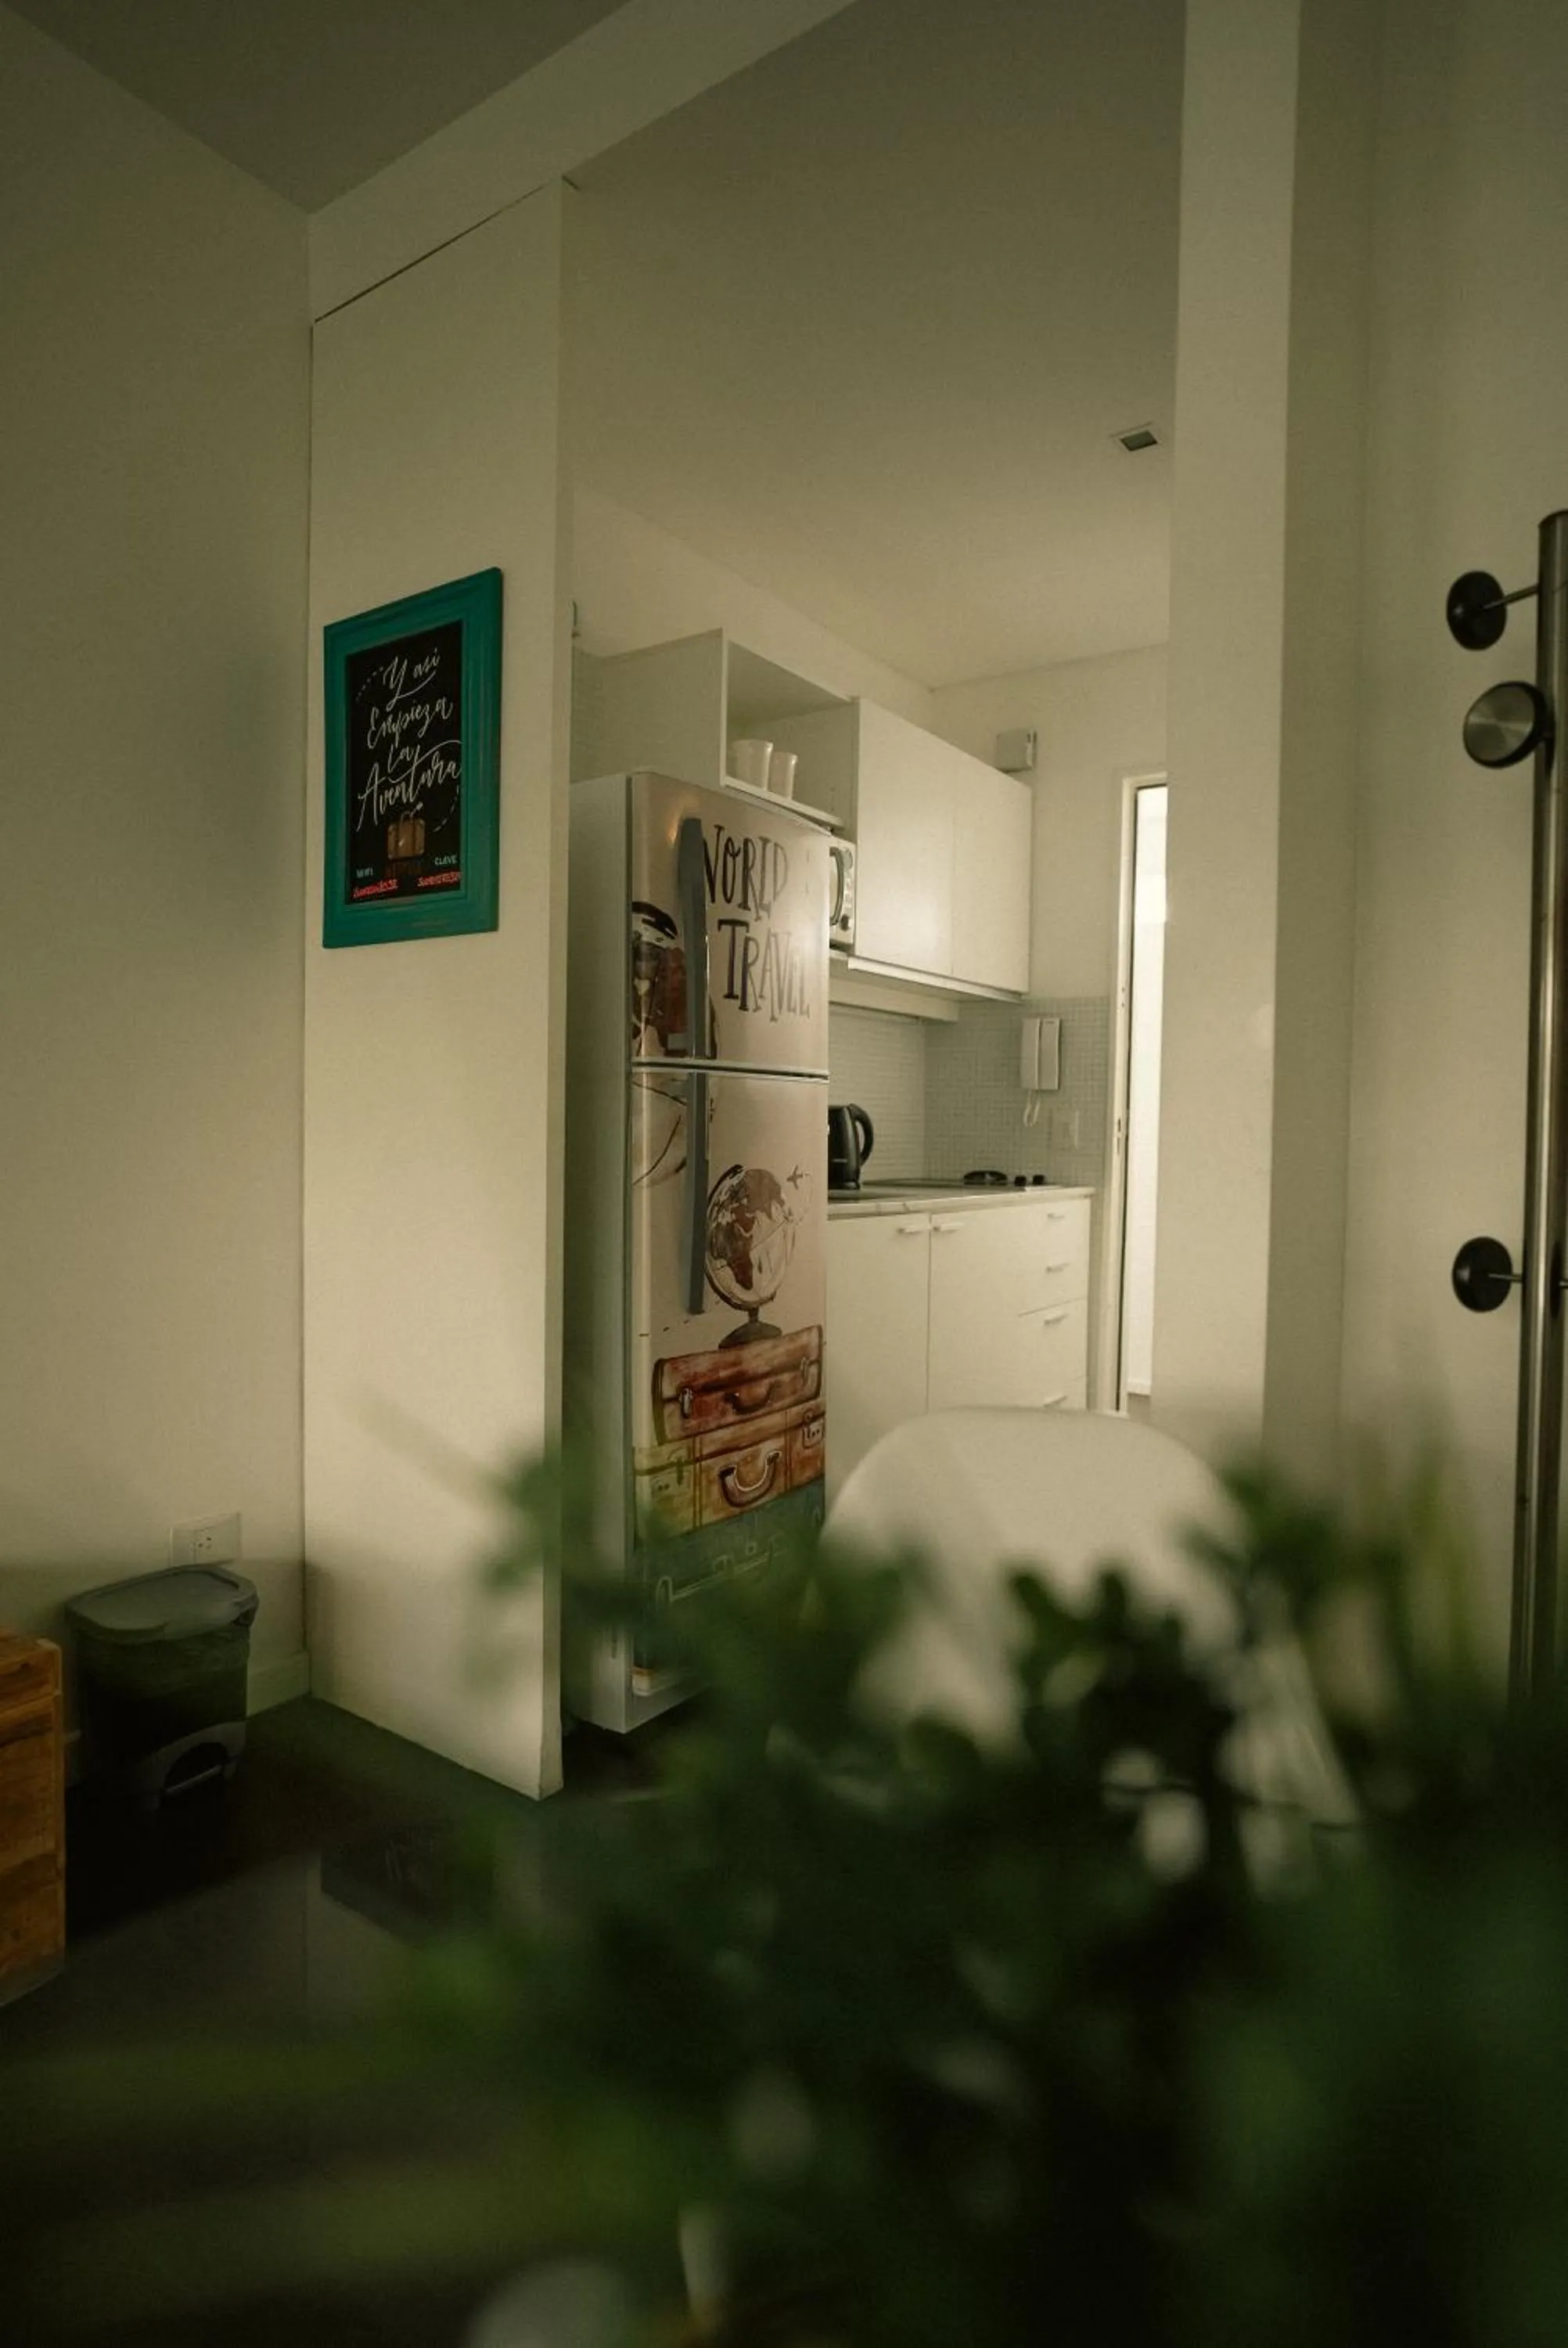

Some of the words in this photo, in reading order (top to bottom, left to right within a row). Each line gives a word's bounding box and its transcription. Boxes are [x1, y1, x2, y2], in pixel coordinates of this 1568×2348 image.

[356, 740, 463, 832] Aventura
[433, 855, 458, 866] CLAVE
[717, 918, 811, 1022] TRAVEL
